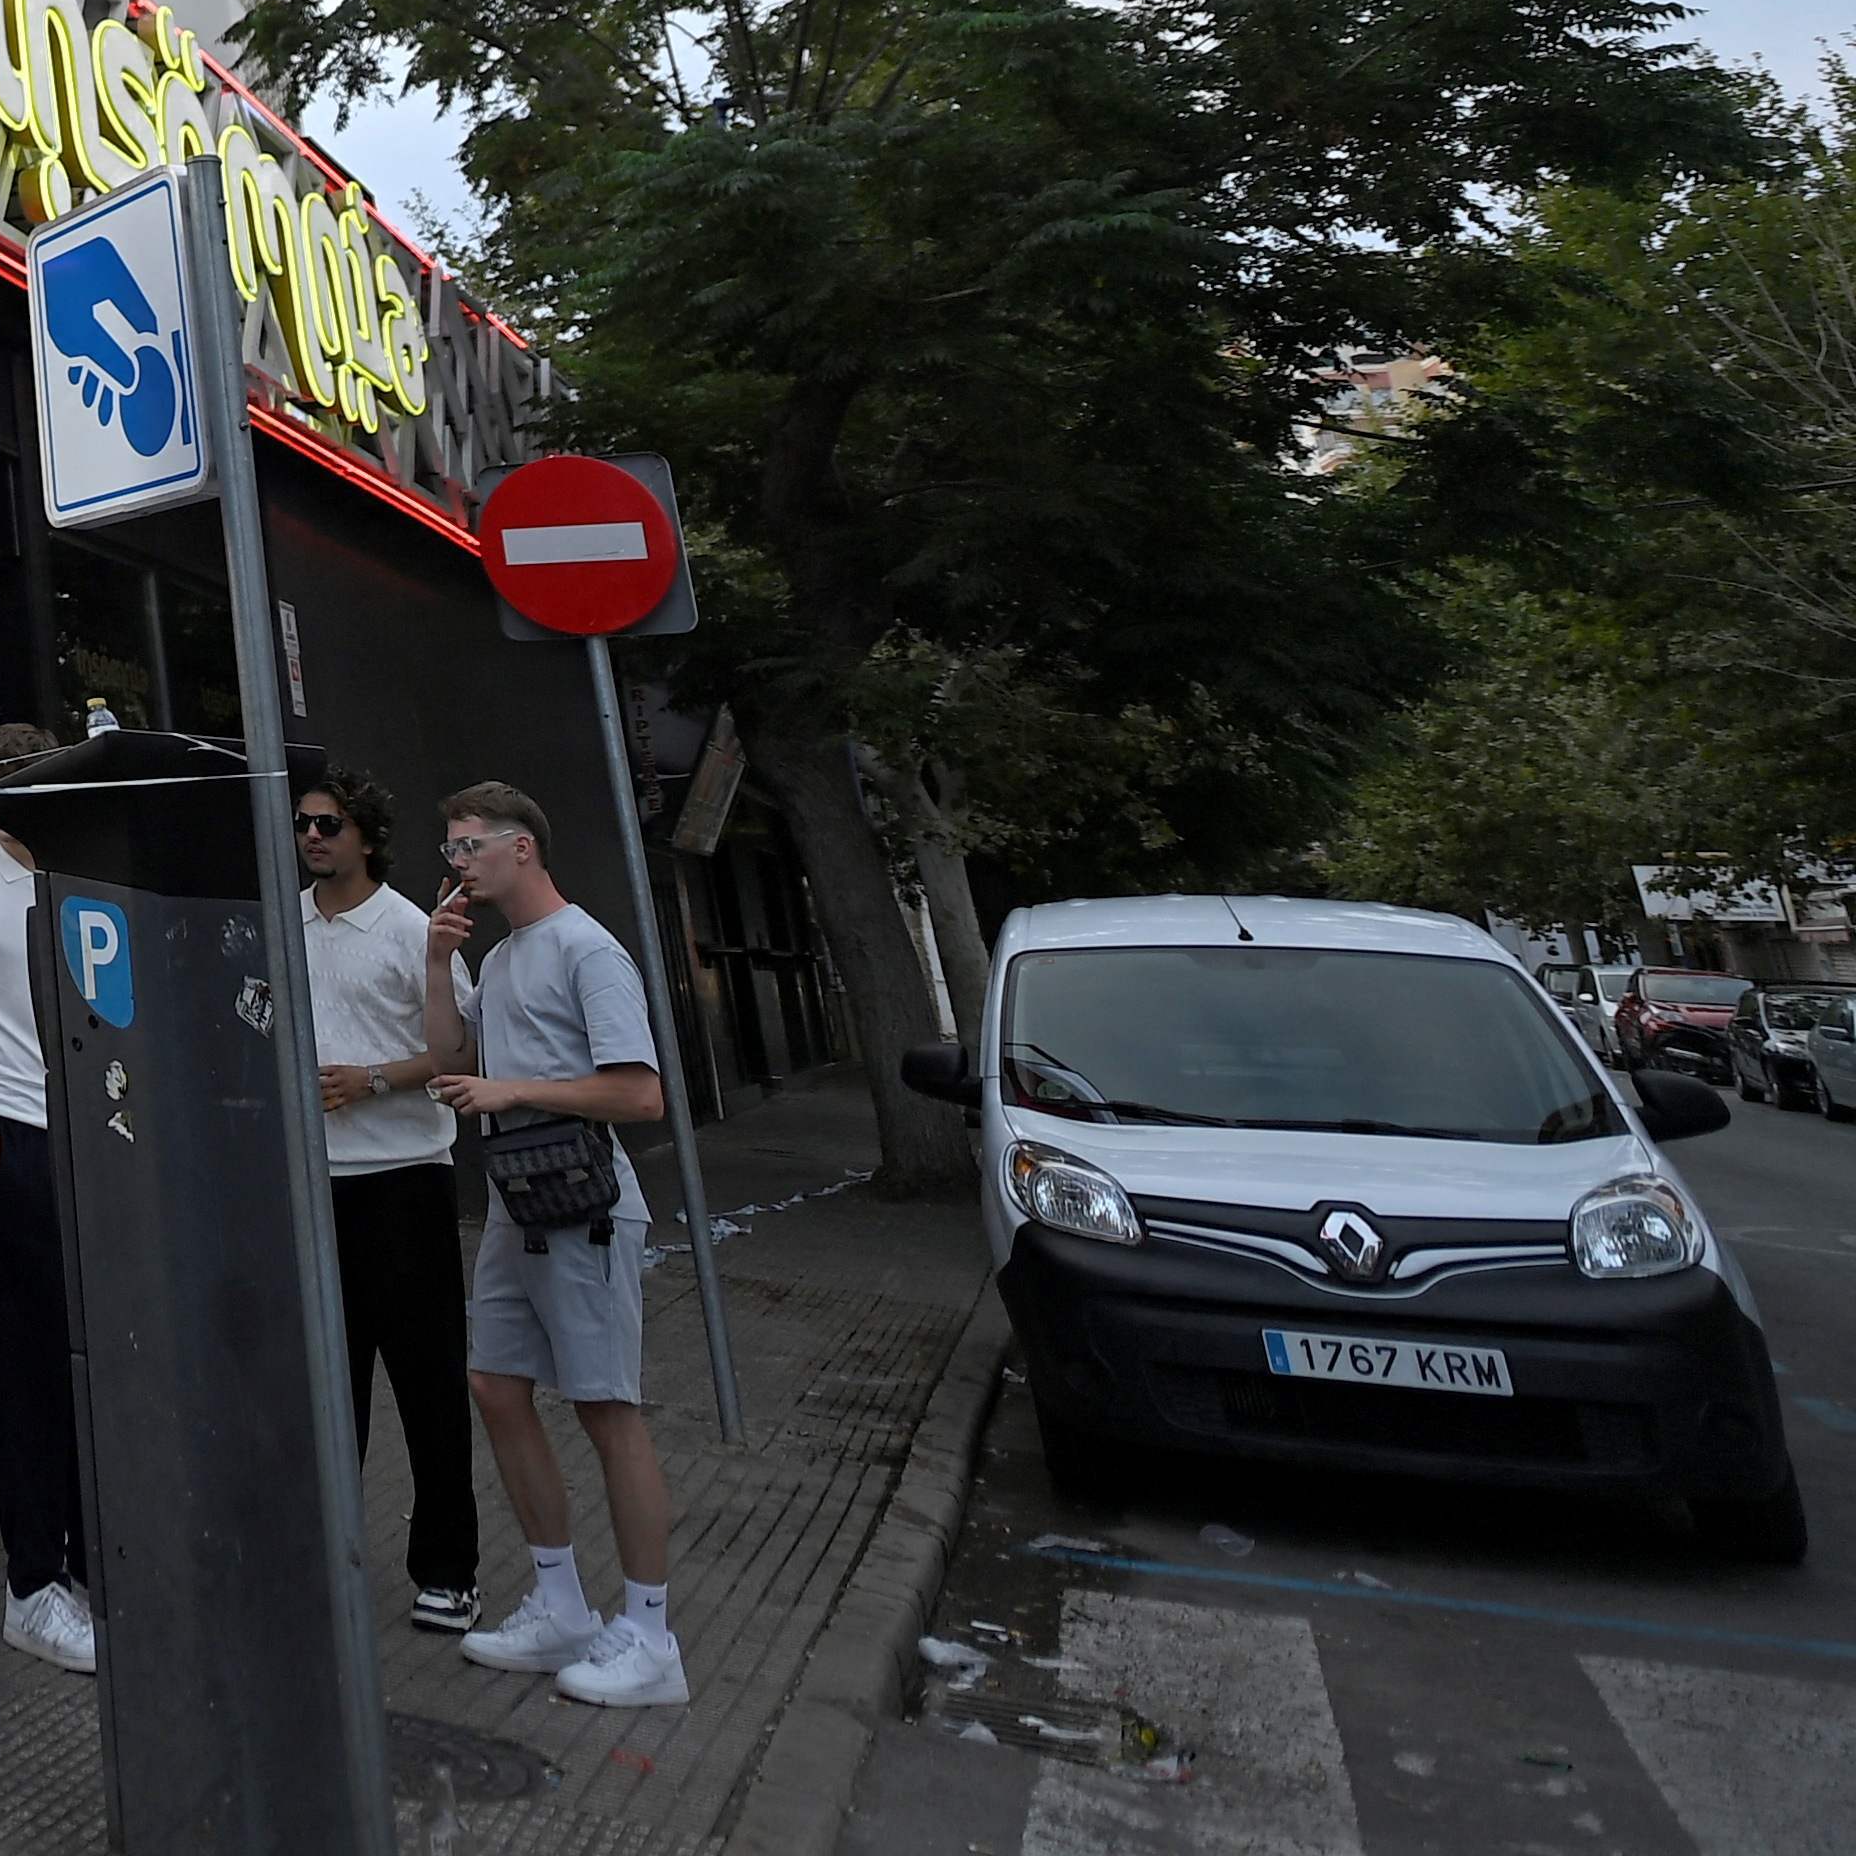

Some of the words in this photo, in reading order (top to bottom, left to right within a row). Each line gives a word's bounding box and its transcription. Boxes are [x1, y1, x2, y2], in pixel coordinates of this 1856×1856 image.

[78, 910, 119, 1001] P
[1299, 1338, 1398, 1379] 1767
[1415, 1349, 1502, 1389] KRM
